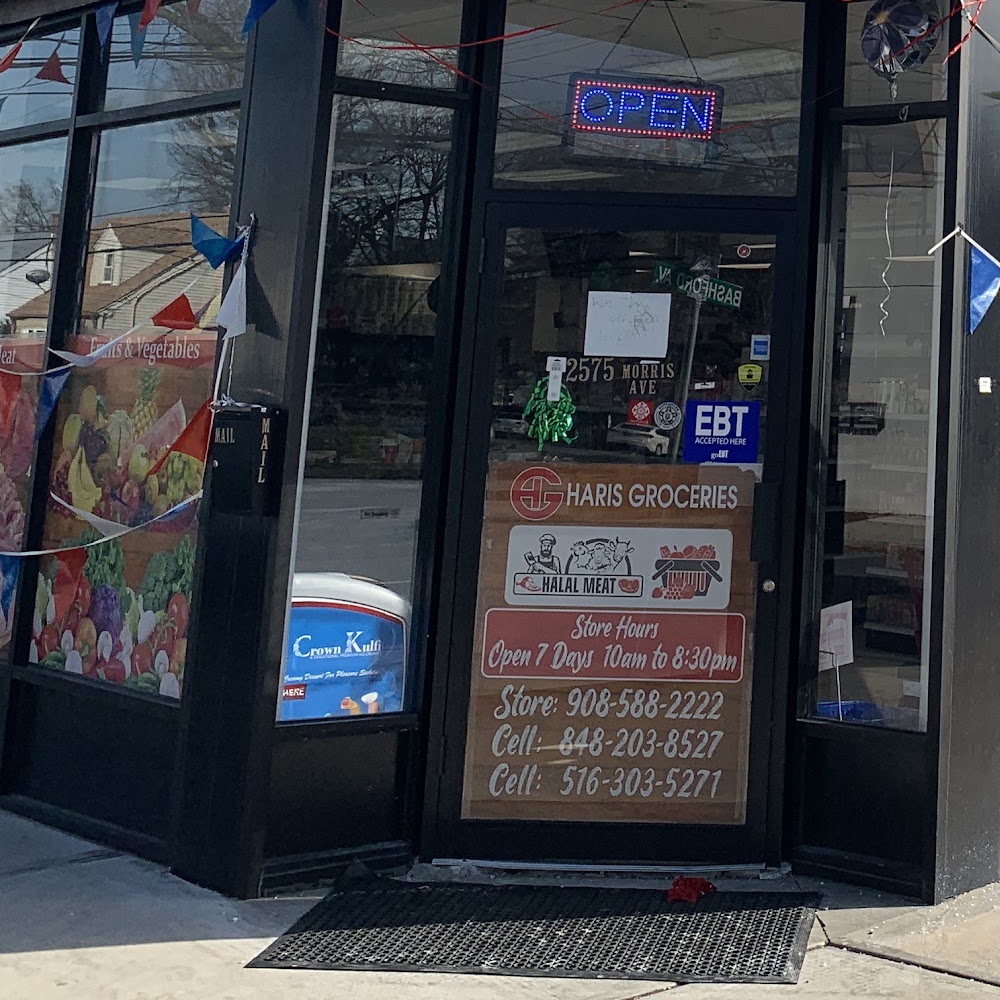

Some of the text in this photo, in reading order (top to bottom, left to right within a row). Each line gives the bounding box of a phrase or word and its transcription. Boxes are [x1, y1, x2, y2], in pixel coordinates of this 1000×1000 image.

[580, 89, 710, 131] OPEN
[0, 345, 16, 365] eat
[90, 336, 200, 365] Fits & Vegetables
[566, 357, 615, 382] 2575
[622, 363, 675, 379] MORRIS
[629, 380, 656, 395] AVE
[695, 405, 749, 437] EBT
[214, 427, 235, 443] MAIL
[695, 437, 746, 445] ACCEPTED HERE
[257, 418, 270, 483] MAIL
[566, 483, 738, 510] HARIS GROCERIES
[541, 577, 616, 594] HALAL MEAT
[571, 614, 659, 641] Store Hours
[293, 631, 381, 657] Crown Kulfi
[488, 640, 737, 676] Open 7 Days 10am to 8:30pm
[494, 684, 725, 720] Store: 908-588-2222
[491, 724, 725, 759] Cell: 848-203-8527
[488, 763, 722, 799] Cell: 516-303-5271
